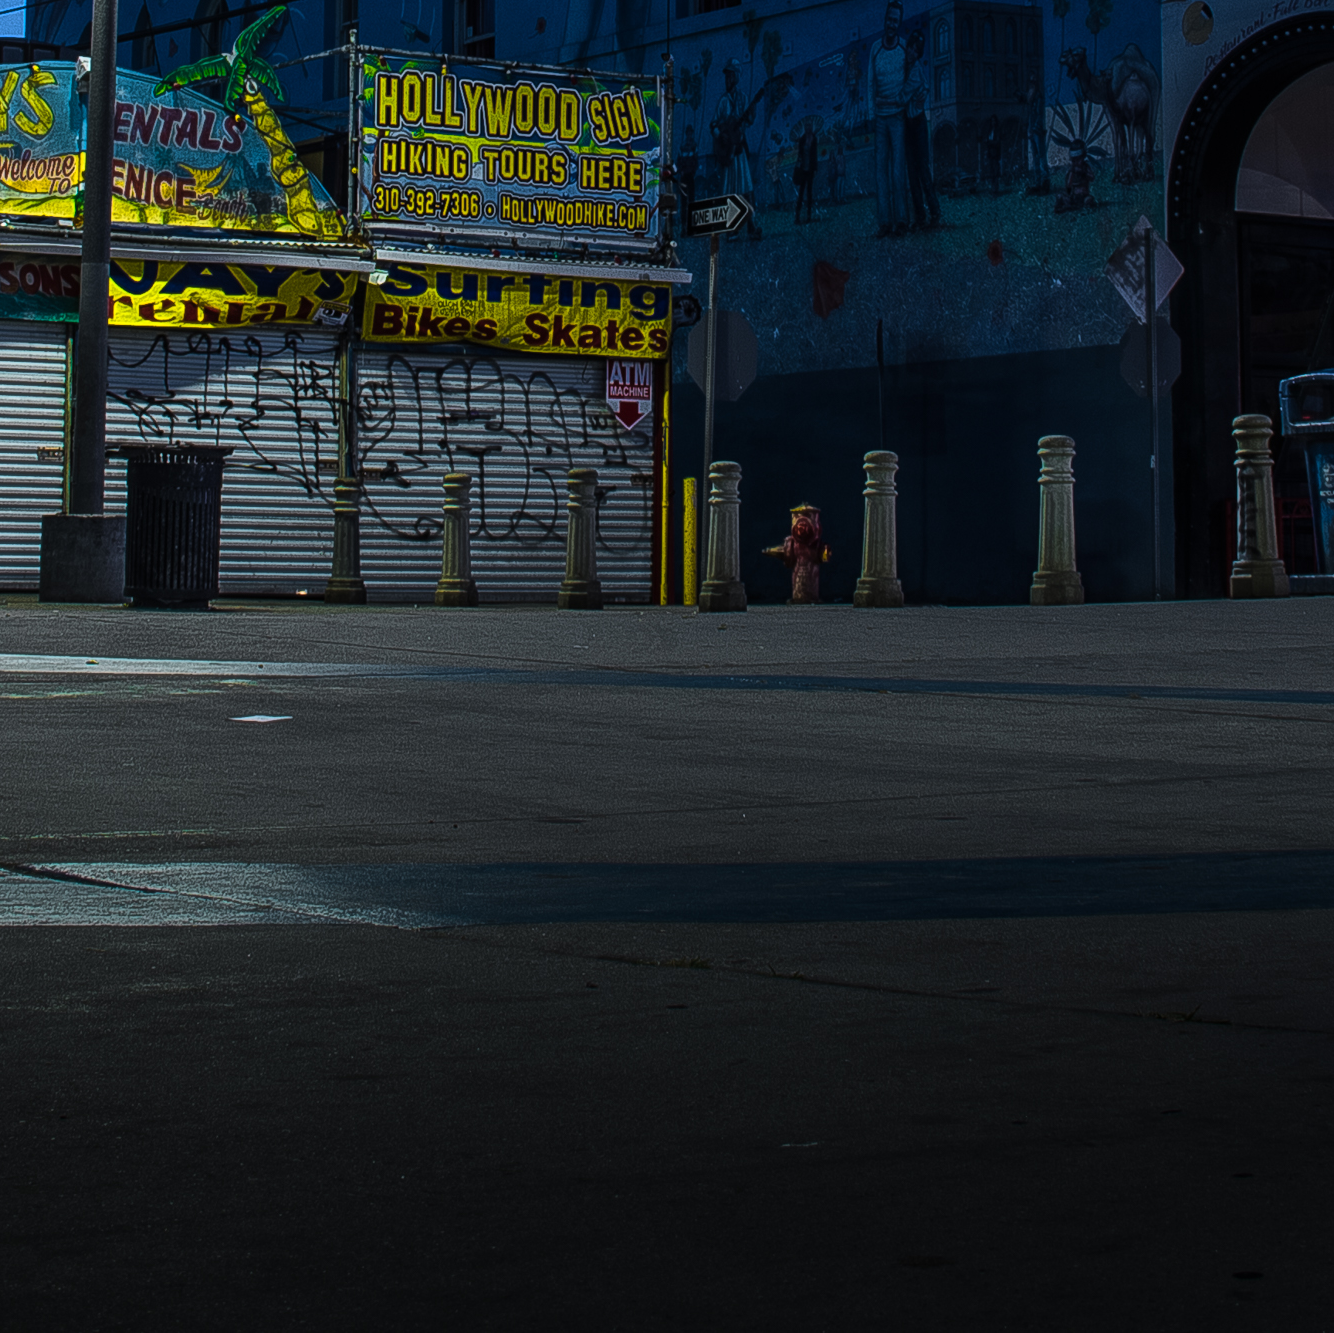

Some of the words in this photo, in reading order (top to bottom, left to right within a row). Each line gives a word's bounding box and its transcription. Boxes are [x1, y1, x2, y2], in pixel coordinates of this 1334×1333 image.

[1203, 11, 1266, 76] Restaurant
[113, 101, 246, 153] ENTALS
[375, 70, 582, 143] HOLLYWOOD
[585, 88, 649, 145] SIGN
[48, 177, 73, 196] TO
[112, 158, 197, 215] ENICE
[380, 138, 471, 183] HIKING
[480, 145, 570, 187] TOURS
[578, 155, 645, 195] HERE
[373, 184, 482, 221] 310-392-7306
[499, 192, 650, 232] HOLLYWOODHIKE.COM
[693, 210, 710, 225] ONE
[711, 206, 729, 221] WAY
[378, 262, 670, 321] Surfing
[371, 302, 498, 341] Bikes
[522, 313, 668, 353] Skates
[608, 360, 651, 386] ATM
[609, 385, 650, 398] MACHINE
